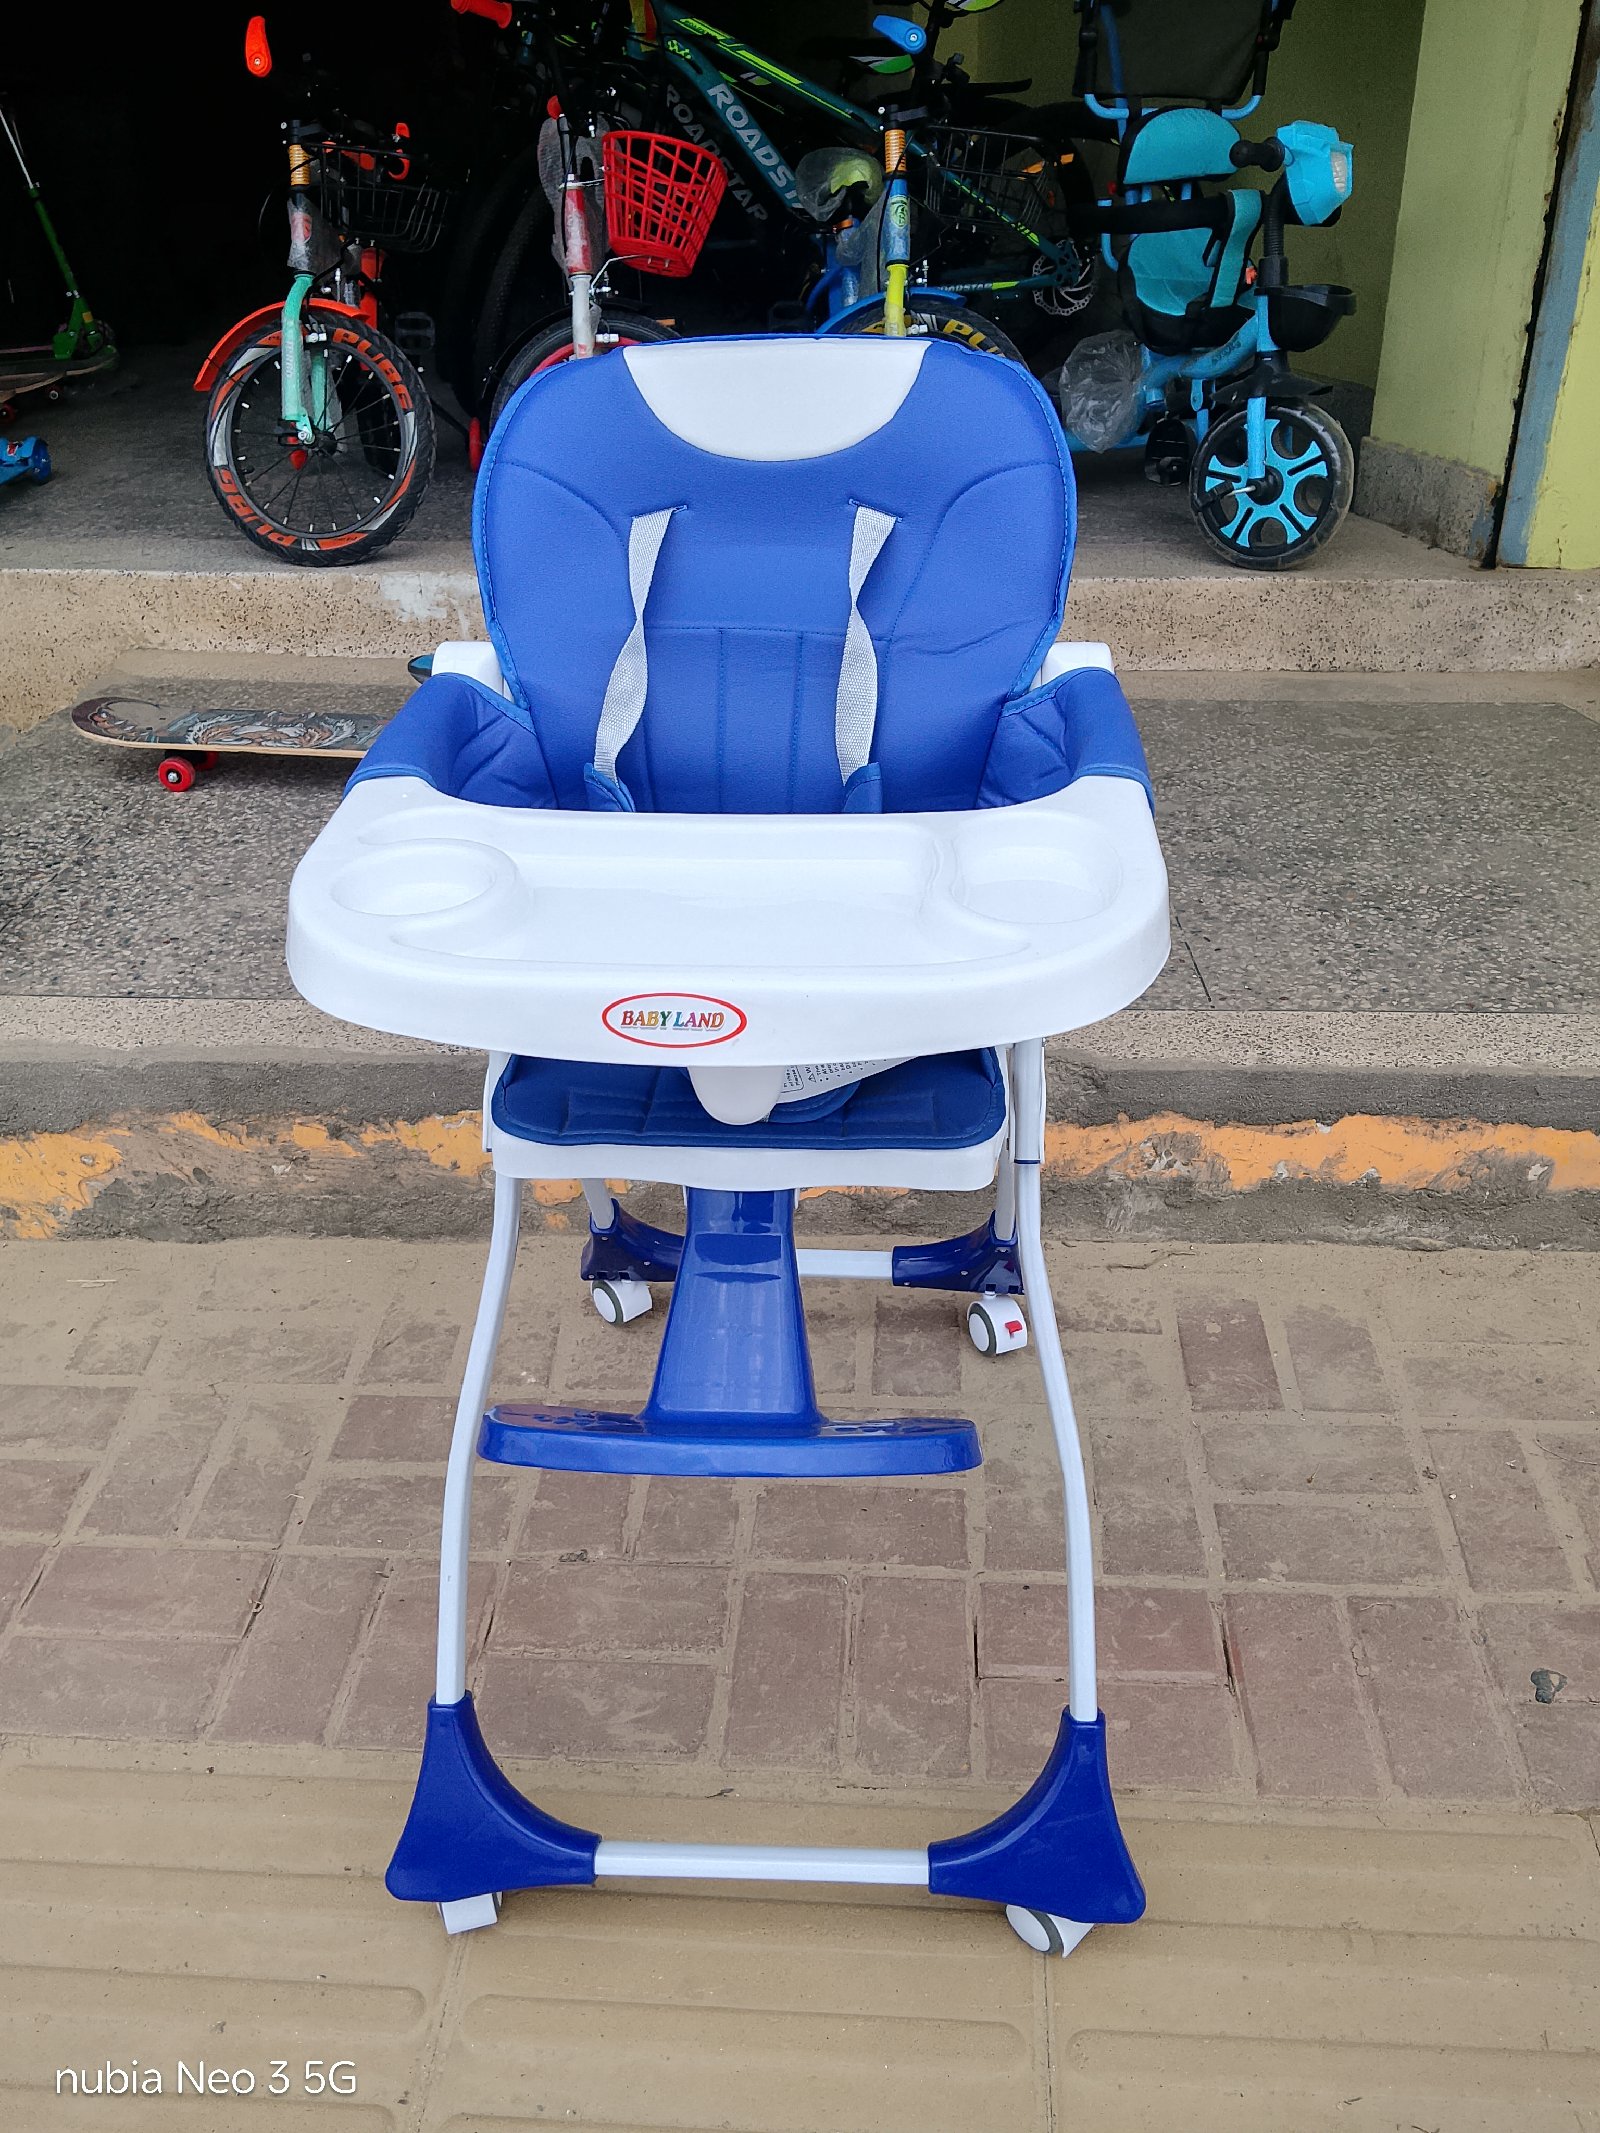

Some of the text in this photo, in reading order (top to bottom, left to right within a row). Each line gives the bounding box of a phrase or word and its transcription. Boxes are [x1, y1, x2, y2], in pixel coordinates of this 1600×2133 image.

[707, 83, 805, 208] ROADS
[332, 327, 414, 411] PUBG
[215, 467, 298, 547] PUBG
[621, 1010, 725, 1029] BABY LAND
